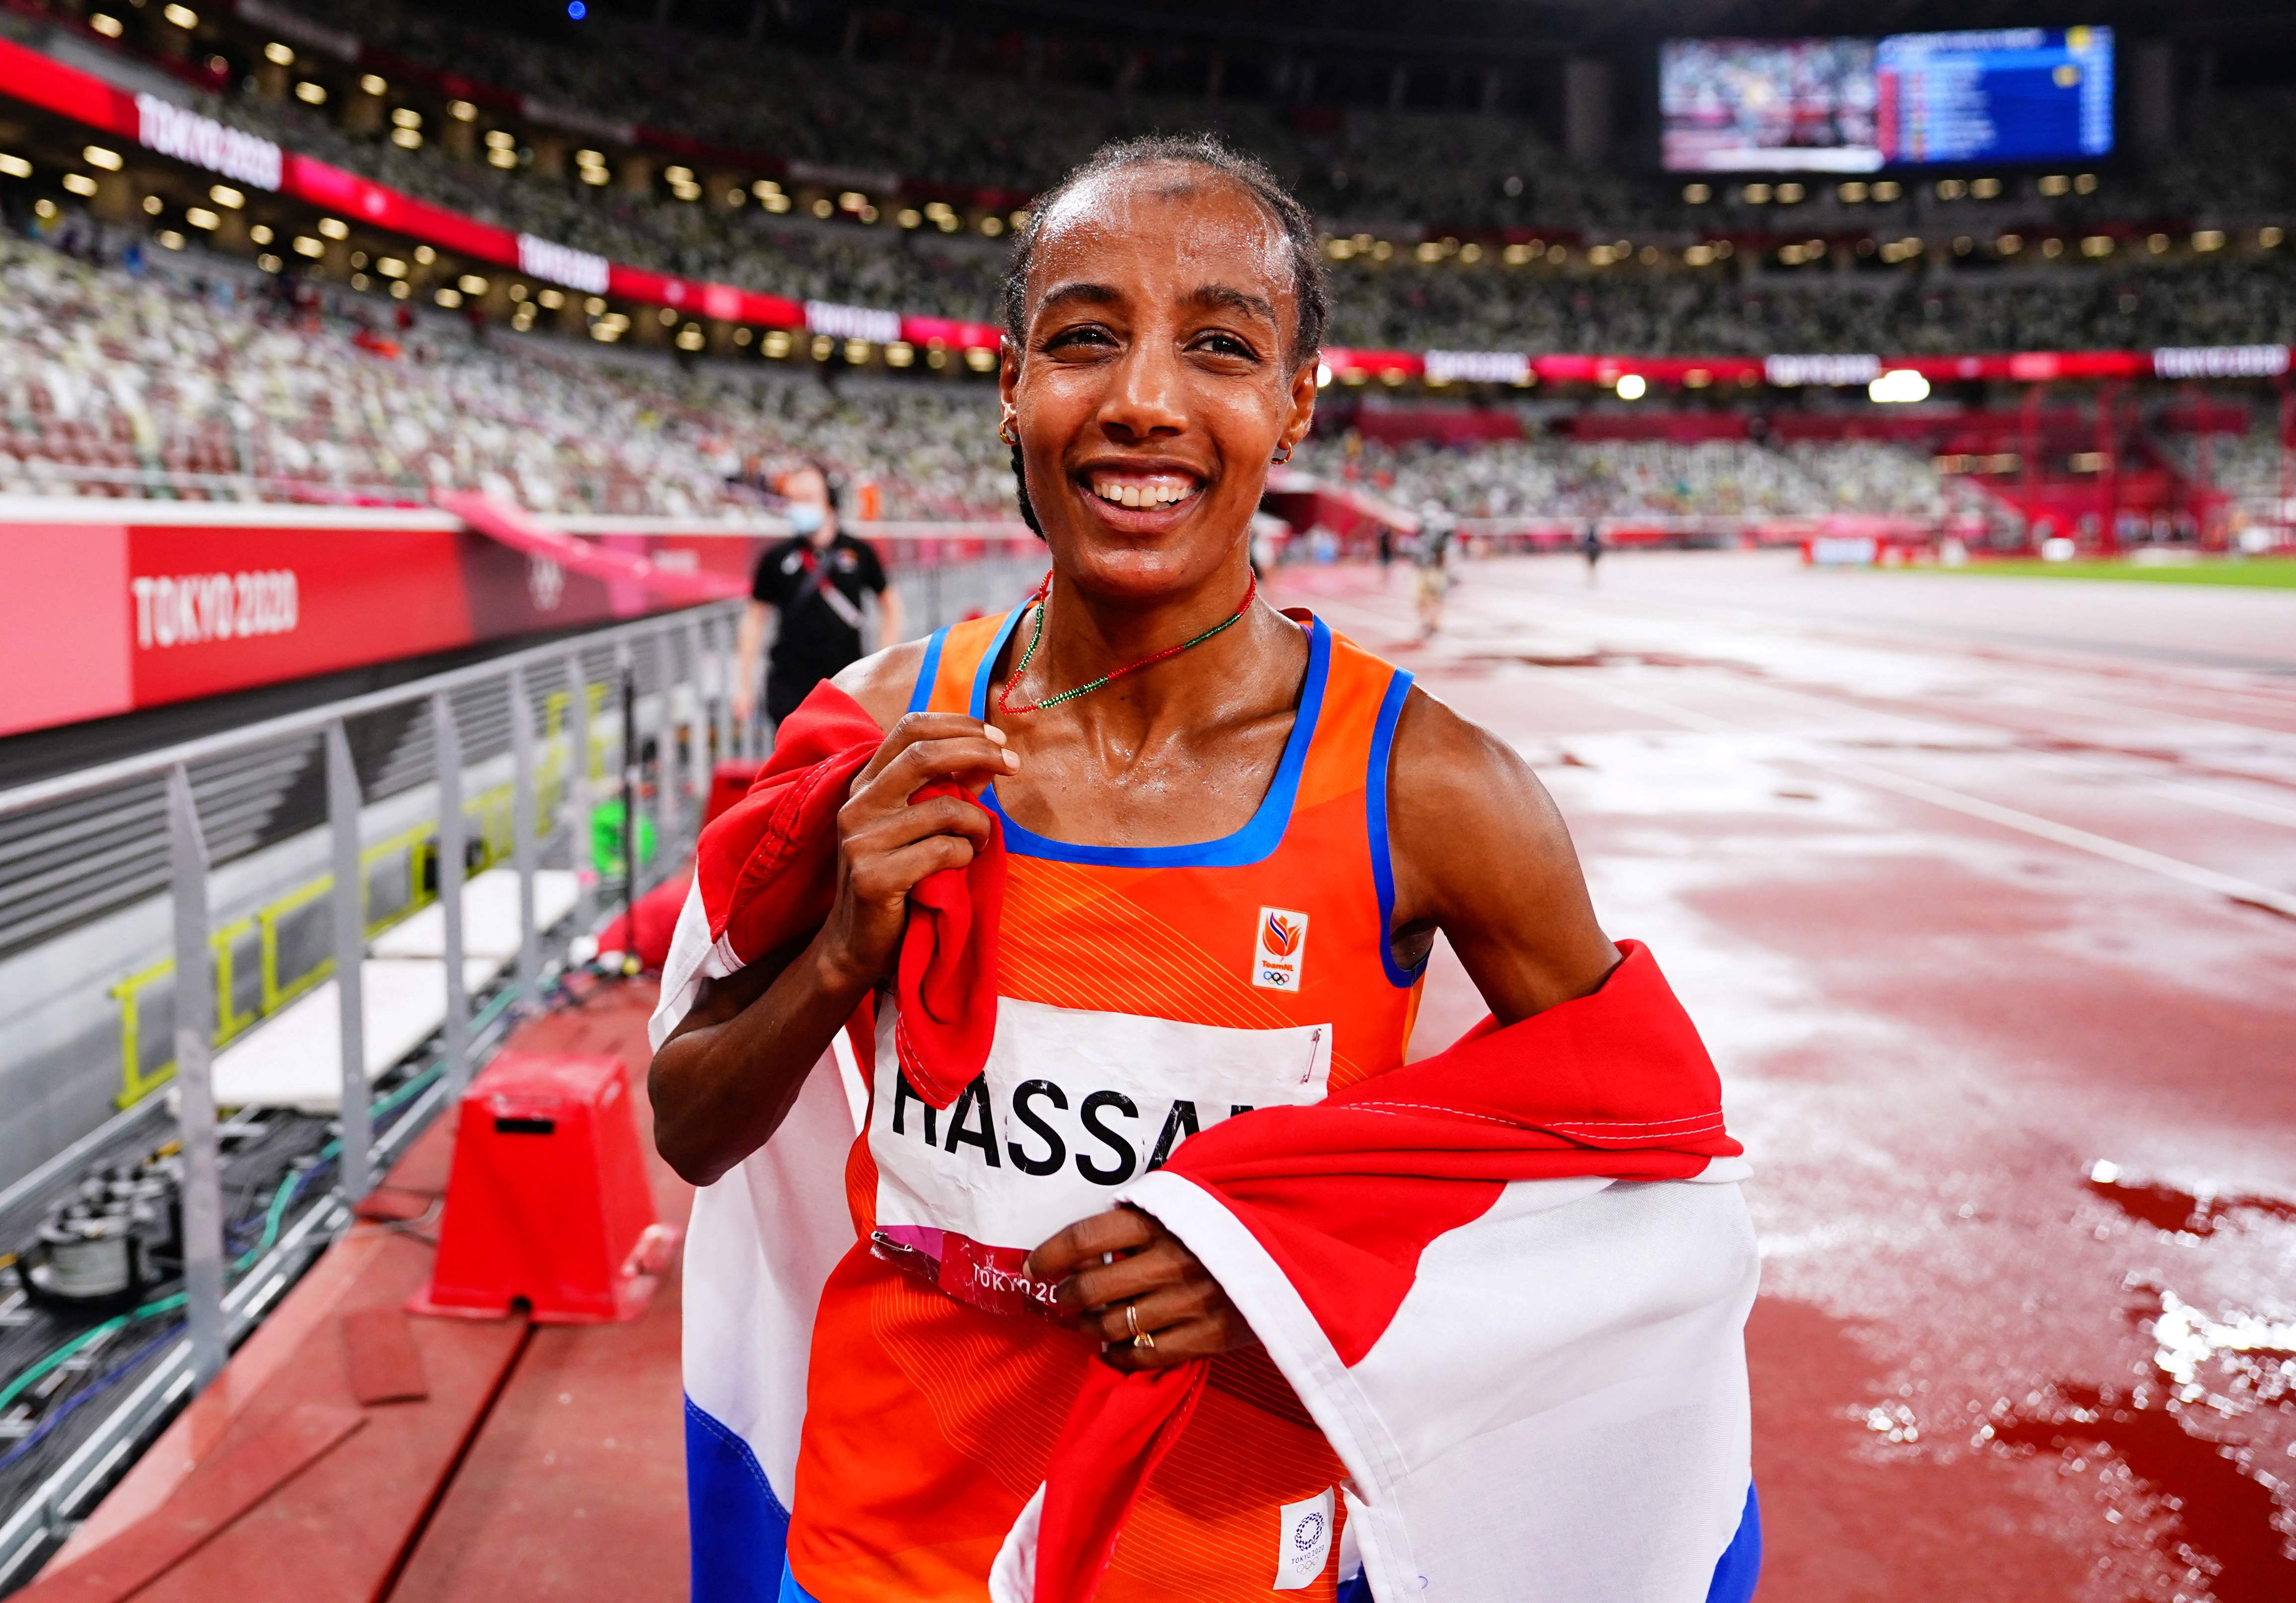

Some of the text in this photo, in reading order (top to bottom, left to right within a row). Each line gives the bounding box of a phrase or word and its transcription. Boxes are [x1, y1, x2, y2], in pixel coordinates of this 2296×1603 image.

[133, 569, 298, 650] TOKYO 2020
[1262, 960, 1294, 972] TeamNL
[893, 1061, 1293, 1185] HASSA
[973, 1263, 1030, 1295] TOKYO
[1291, 1544, 1325, 1565] TOKYO 2020
